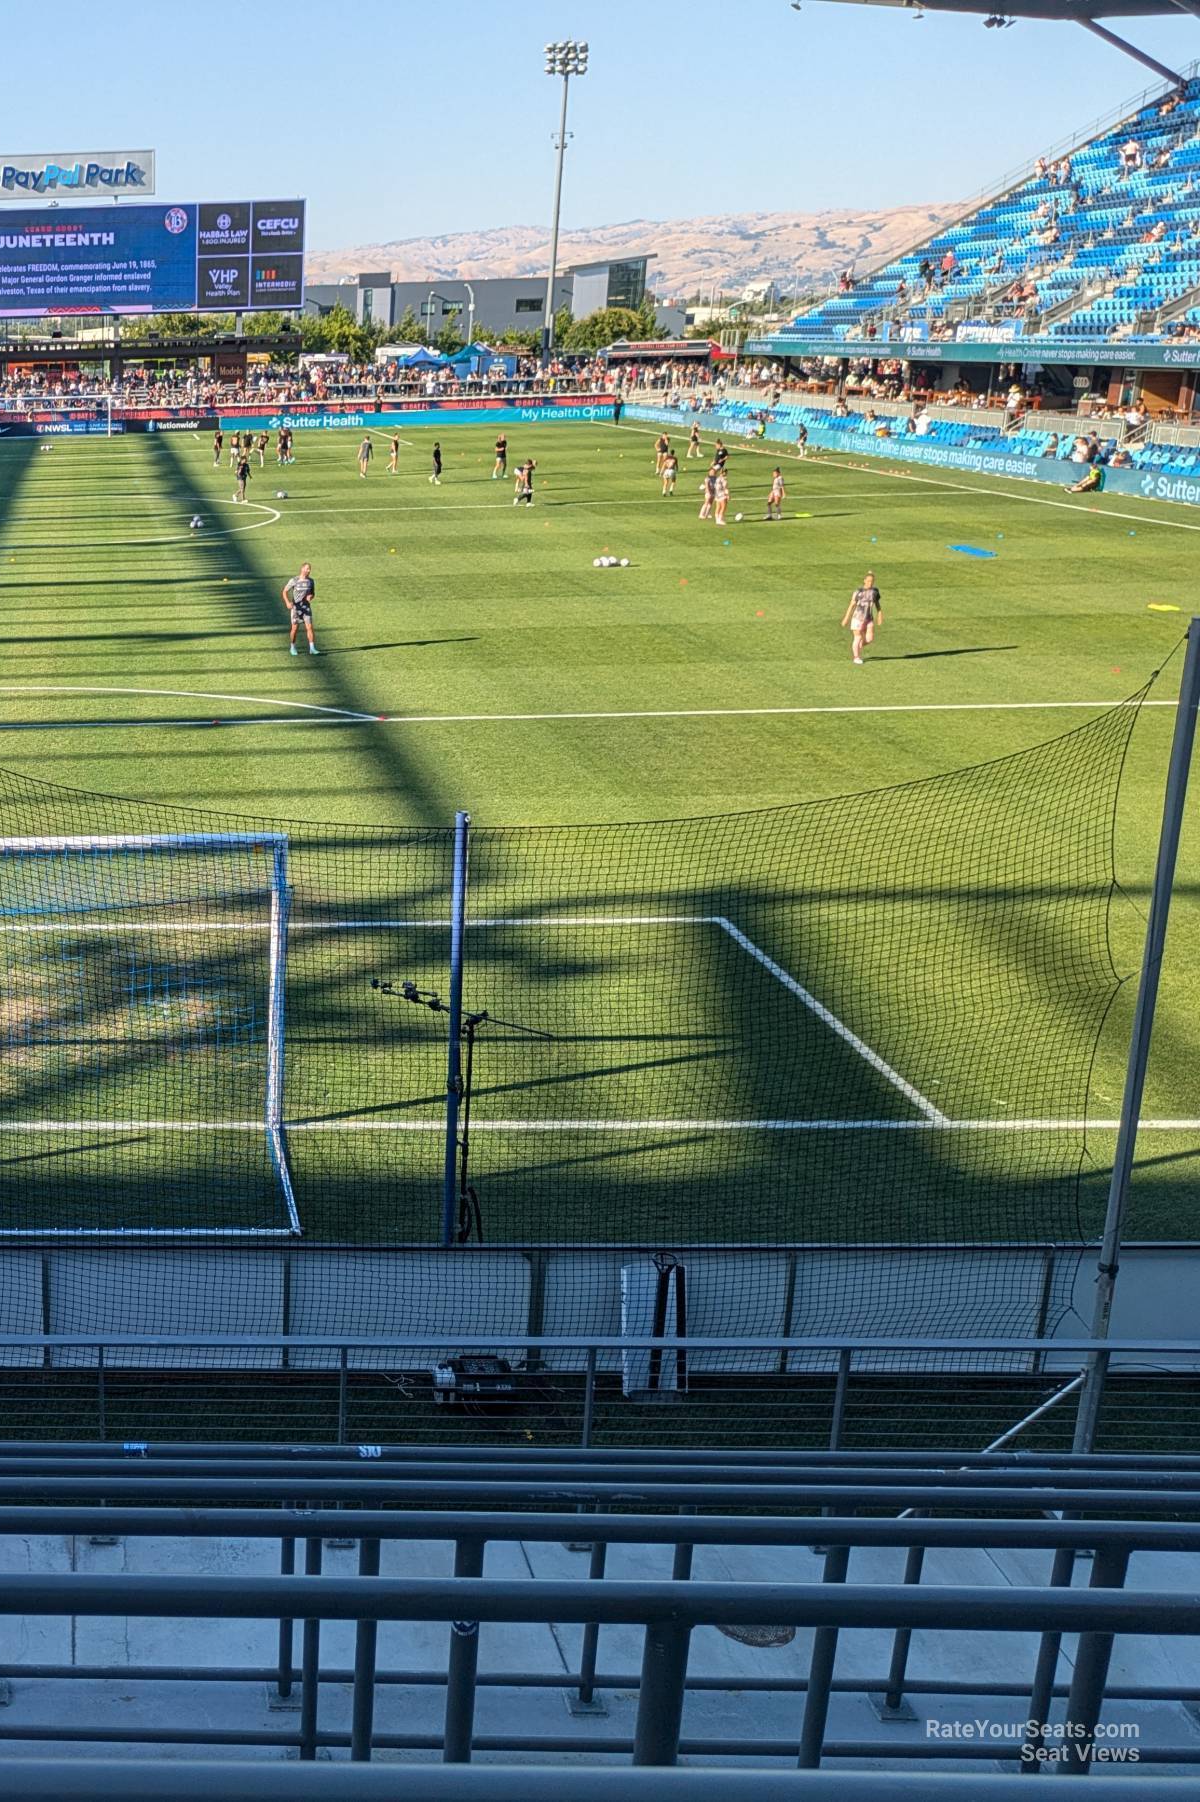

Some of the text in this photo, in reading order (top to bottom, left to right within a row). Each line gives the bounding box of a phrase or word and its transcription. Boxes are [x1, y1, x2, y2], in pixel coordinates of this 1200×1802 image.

[2, 162, 79, 190] PayPal
[85, 161, 138, 187] Park
[257, 217, 299, 230] CEFCU
[28, 263, 59, 272] FREEDOM,
[61, 262, 111, 272] commemorating
[112, 261, 127, 270] June
[2, 275, 19, 286] Major
[21, 275, 44, 284] General
[45, 273, 67, 283] Gordon
[69, 273, 93, 283] Granger
[95, 272, 122, 281] informed
[124, 271, 151, 280] enslaved
[208, 269, 239, 283] VHP
[26, 286, 45, 295] Texas
[46, 285, 53, 294] of
[54, 285, 68, 294] their
[70, 284, 111, 293] emancipation
[112, 283, 127, 292] from
[128, 283, 152, 293] slavery.
[1004, 348, 1022, 357] Health
[1023, 348, 1040, 357] Online
[1041, 349, 1057, 358] never
[1057, 348, 1075, 360] stops
[1076, 348, 1098, 361] making
[1100, 350, 1115, 359] care
[1172, 349, 1196, 362] Sutter
[522, 409, 538, 420] My
[541, 406, 580, 418] Health
[583, 406, 614, 418] Onlin
[283, 415, 363, 428] Sutter Health
[45, 424, 72, 433] NWSL
[851, 435, 874, 451] Health
[875, 438, 900, 455] Online
[900, 444, 923, 457] never
[923, 446, 948, 465] stops
[949, 449, 982, 471] making
[983, 456, 1004, 471] care
[1005, 458, 1038, 476] easier.
[1156, 476, 1200, 502] Sutter
